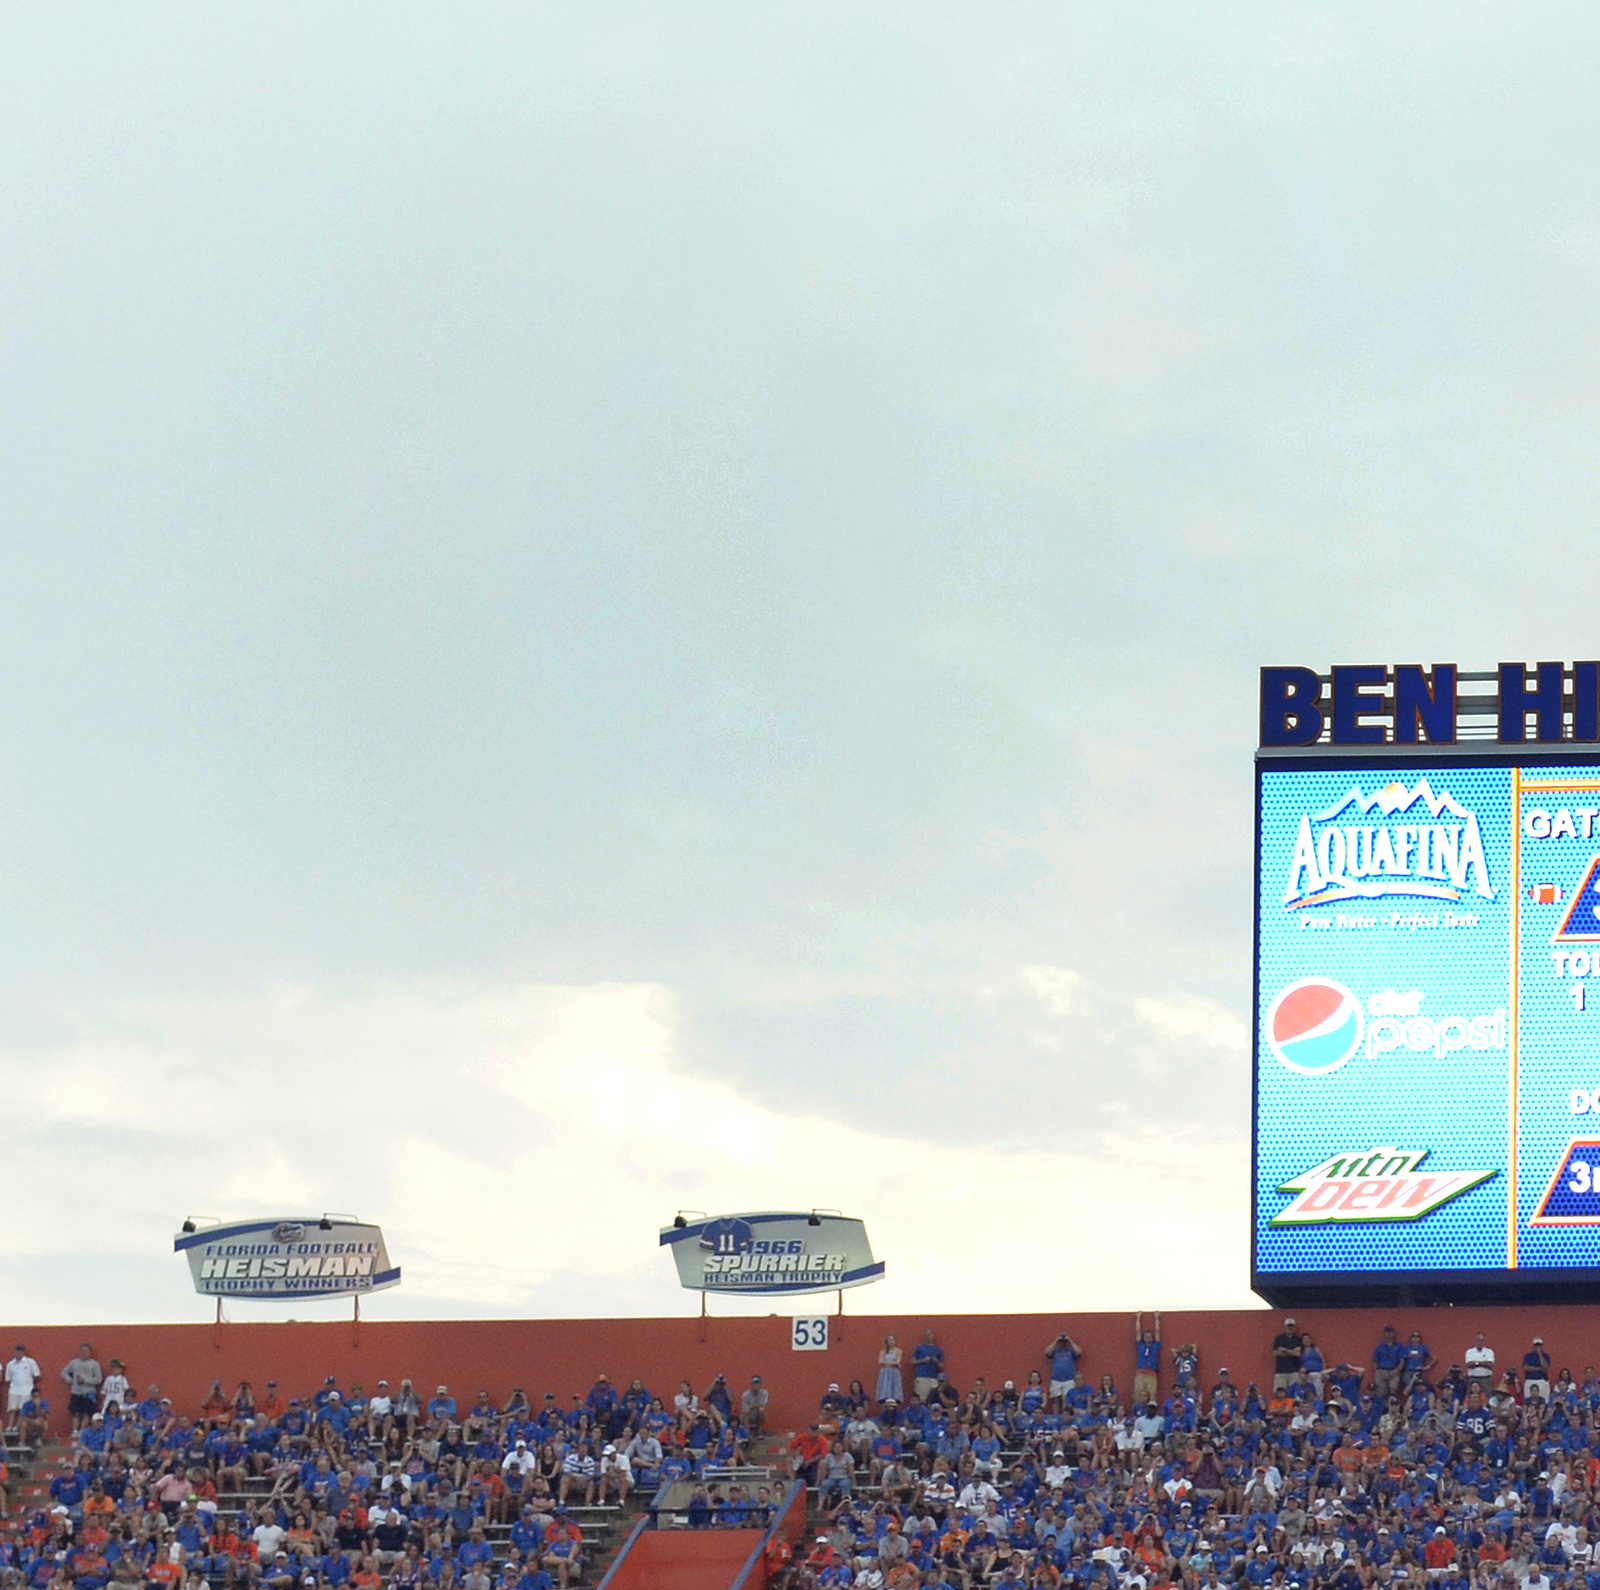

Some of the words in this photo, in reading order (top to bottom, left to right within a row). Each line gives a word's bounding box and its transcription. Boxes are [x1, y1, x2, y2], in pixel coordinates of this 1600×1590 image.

[1260, 663, 1457, 748] BEN
[1284, 811, 1498, 900] AQUAFINA
[1569, 981, 1587, 1010] 1
[205, 1243, 281, 1257] FLORIDA
[286, 1241, 377, 1256] FOOTBALL
[718, 1234, 735, 1253] 11
[746, 1239, 804, 1255] 1966
[201, 1256, 377, 1280] HEISMAN
[703, 1254, 846, 1274] SPURRIER
[204, 1279, 276, 1291] TROPHY
[703, 1272, 777, 1284] HEISMAN
[780, 1271, 843, 1283] TROPHY
[793, 1319, 827, 1346] 53
